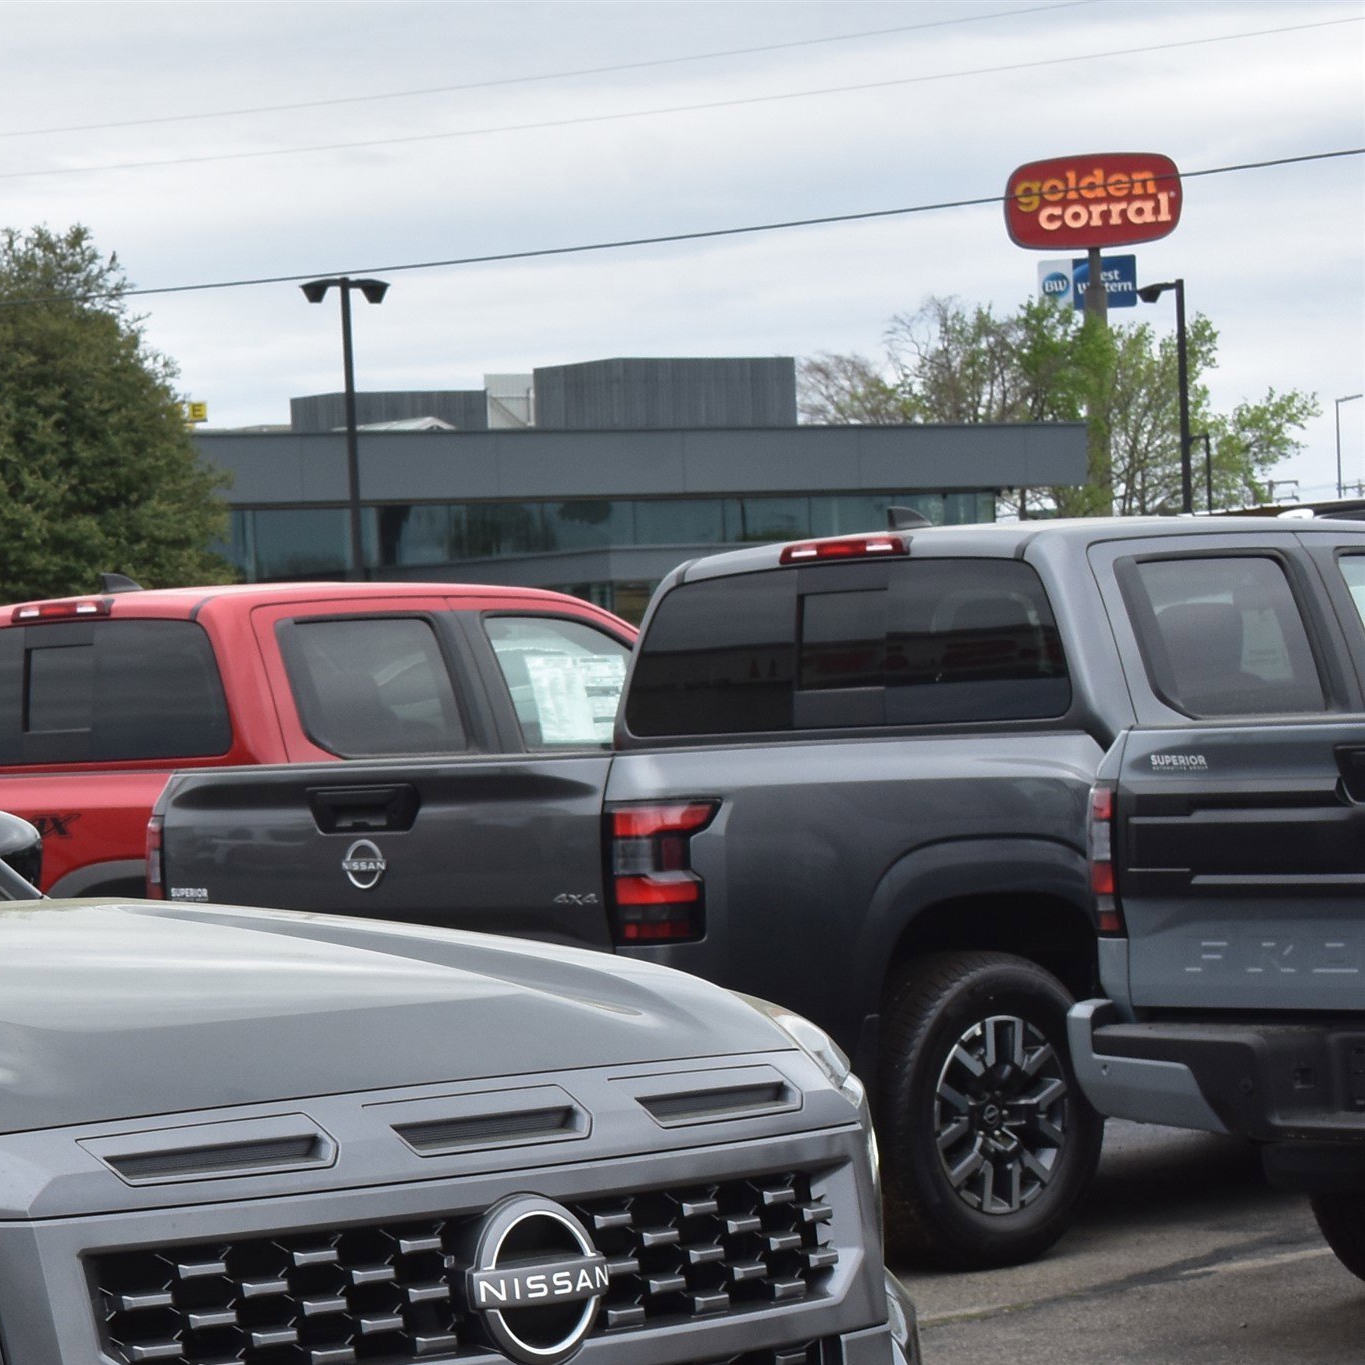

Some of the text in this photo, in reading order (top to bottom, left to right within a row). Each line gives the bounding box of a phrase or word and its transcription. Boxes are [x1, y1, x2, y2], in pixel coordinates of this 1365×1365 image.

[1015, 168, 1157, 212] golden
[1038, 192, 1172, 231] corral
[1100, 269, 1120, 281] est
[1044, 279, 1068, 293] BW
[1077, 280, 1132, 295] Wtern
[1150, 754, 1207, 766] SUPERIOR
[342, 861, 386, 871] NISSAN
[171, 887, 208, 898] SUPERIOR
[478, 1264, 610, 1303] NISSAN
